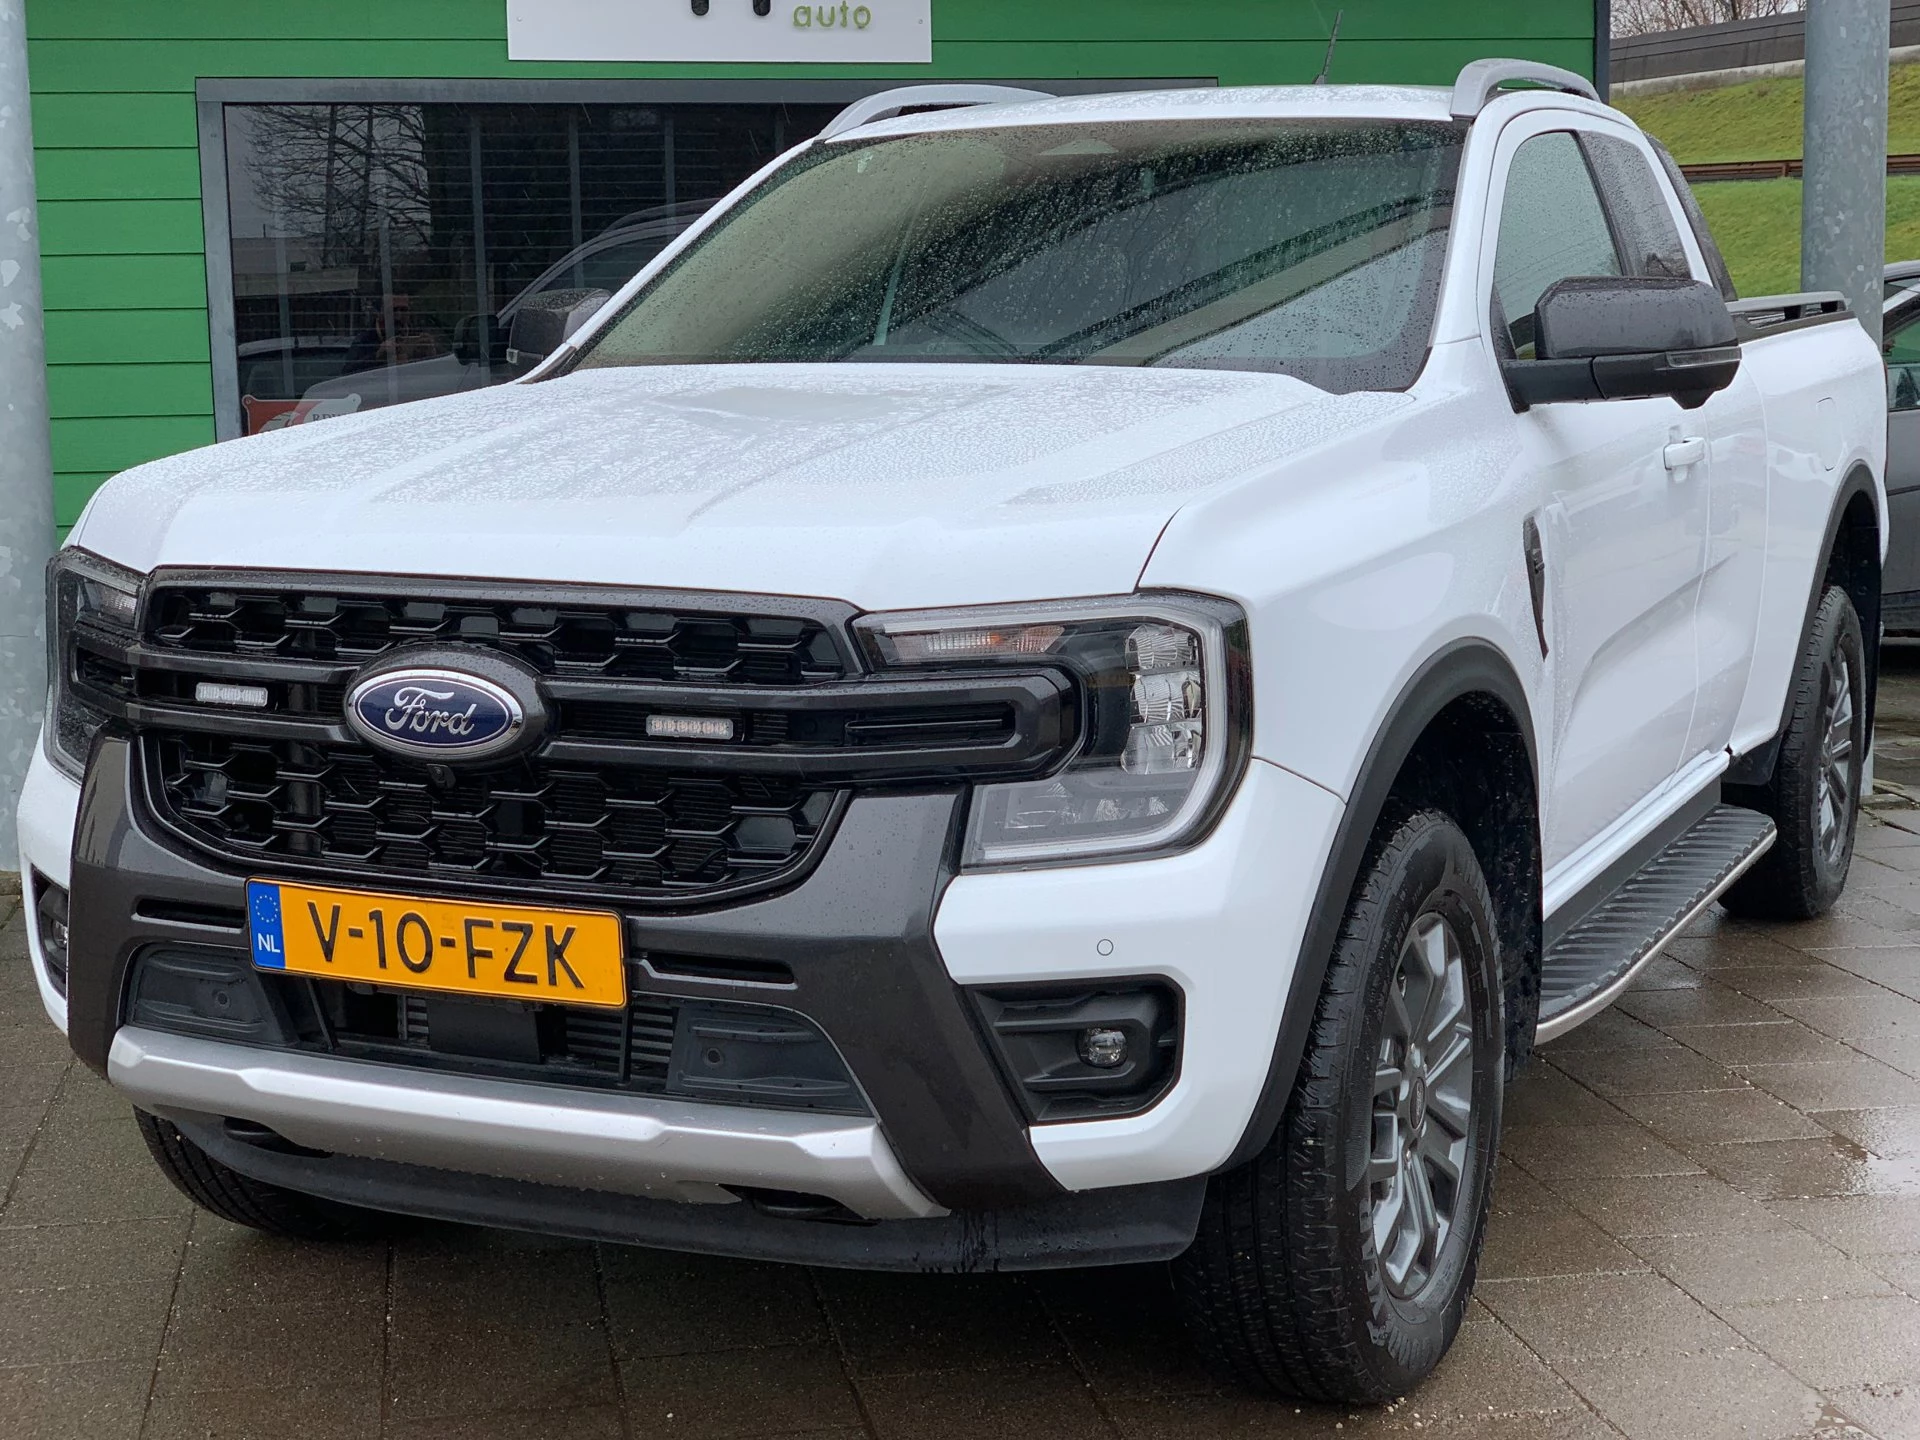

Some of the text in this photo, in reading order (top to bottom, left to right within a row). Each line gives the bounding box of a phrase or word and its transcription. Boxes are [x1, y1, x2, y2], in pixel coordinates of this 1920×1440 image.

[793, 0, 871, 29] auto
[385, 686, 477, 735] Ford
[257, 932, 281, 953] NL
[307, 900, 585, 989] V-10-FZK
